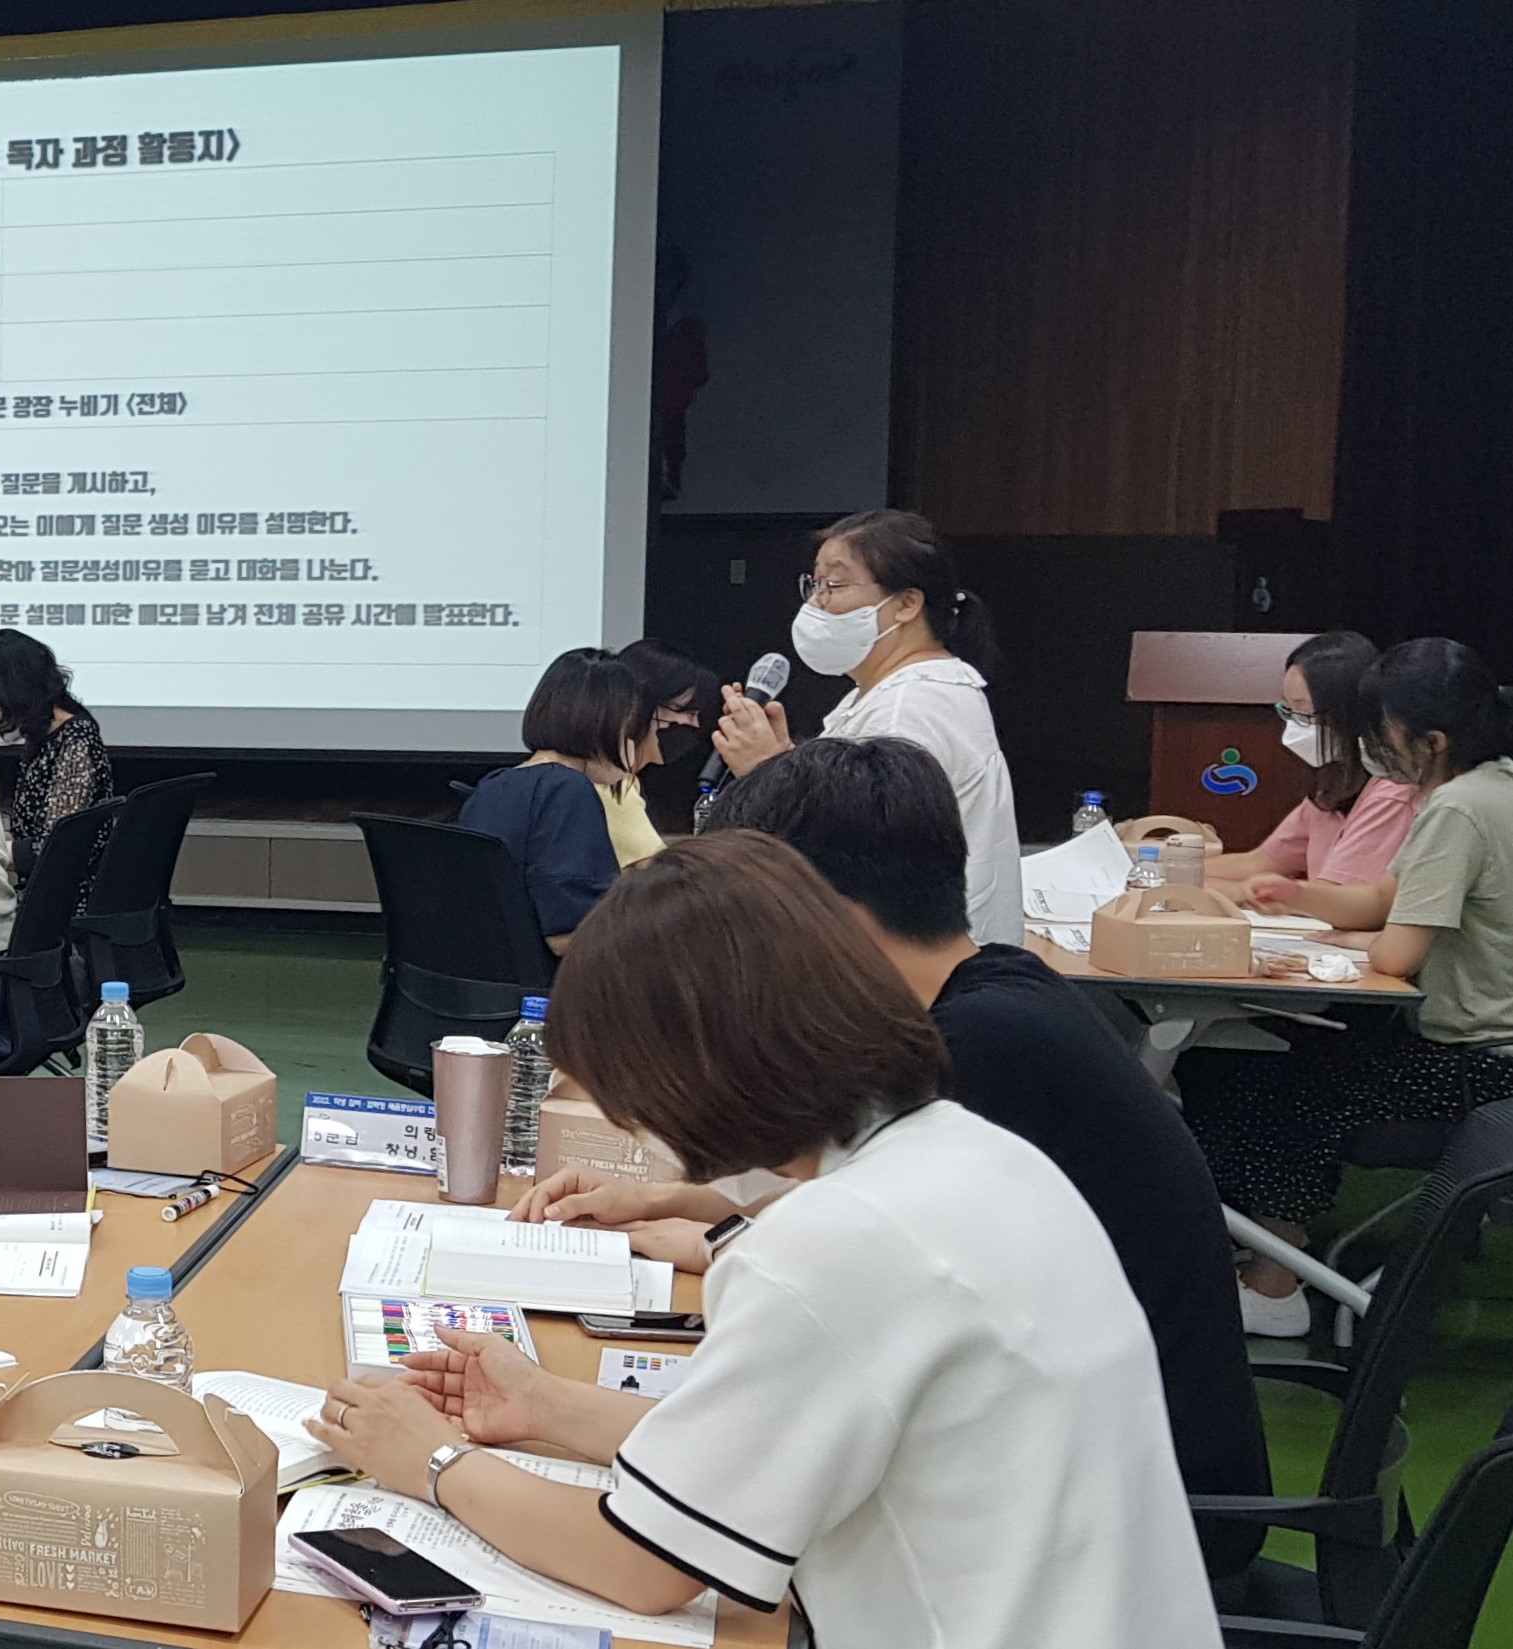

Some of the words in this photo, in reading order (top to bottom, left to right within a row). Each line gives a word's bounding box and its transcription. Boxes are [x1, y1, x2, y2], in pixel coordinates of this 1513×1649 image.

[7, 138, 64, 170] 독자
[72, 135, 127, 168] 과정
[13, 396, 53, 418] 광장
[59, 394, 118, 416] 누비기
[1, 473, 61, 495] 질문을
[67, 471, 155, 496] 게시하고,
[36, 515, 96, 536] 이에게
[102, 514, 143, 535] 질문
[148, 513, 188, 535] 생성
[197, 513, 258, 535] 이유를
[265, 511, 357, 534] 설명한다.
[40, 559, 183, 582] 질문생성이유를
[237, 558, 300, 581] 대화를
[307, 559, 378, 581] 나눈다.
[26, 604, 86, 625] 설명에
[92, 603, 133, 625] 대한
[138, 604, 200, 625] 메모를
[206, 604, 247, 625] 남겨
[254, 603, 296, 625] 전체
[302, 604, 345, 626] 공유
[351, 604, 416, 626] 시간에
[423, 602, 519, 627] 발표한다.
[30, 1544, 66, 1558] FRESH
[70, 1550, 116, 1564] MARKET
[30, 1560, 66, 1590] LOVE
